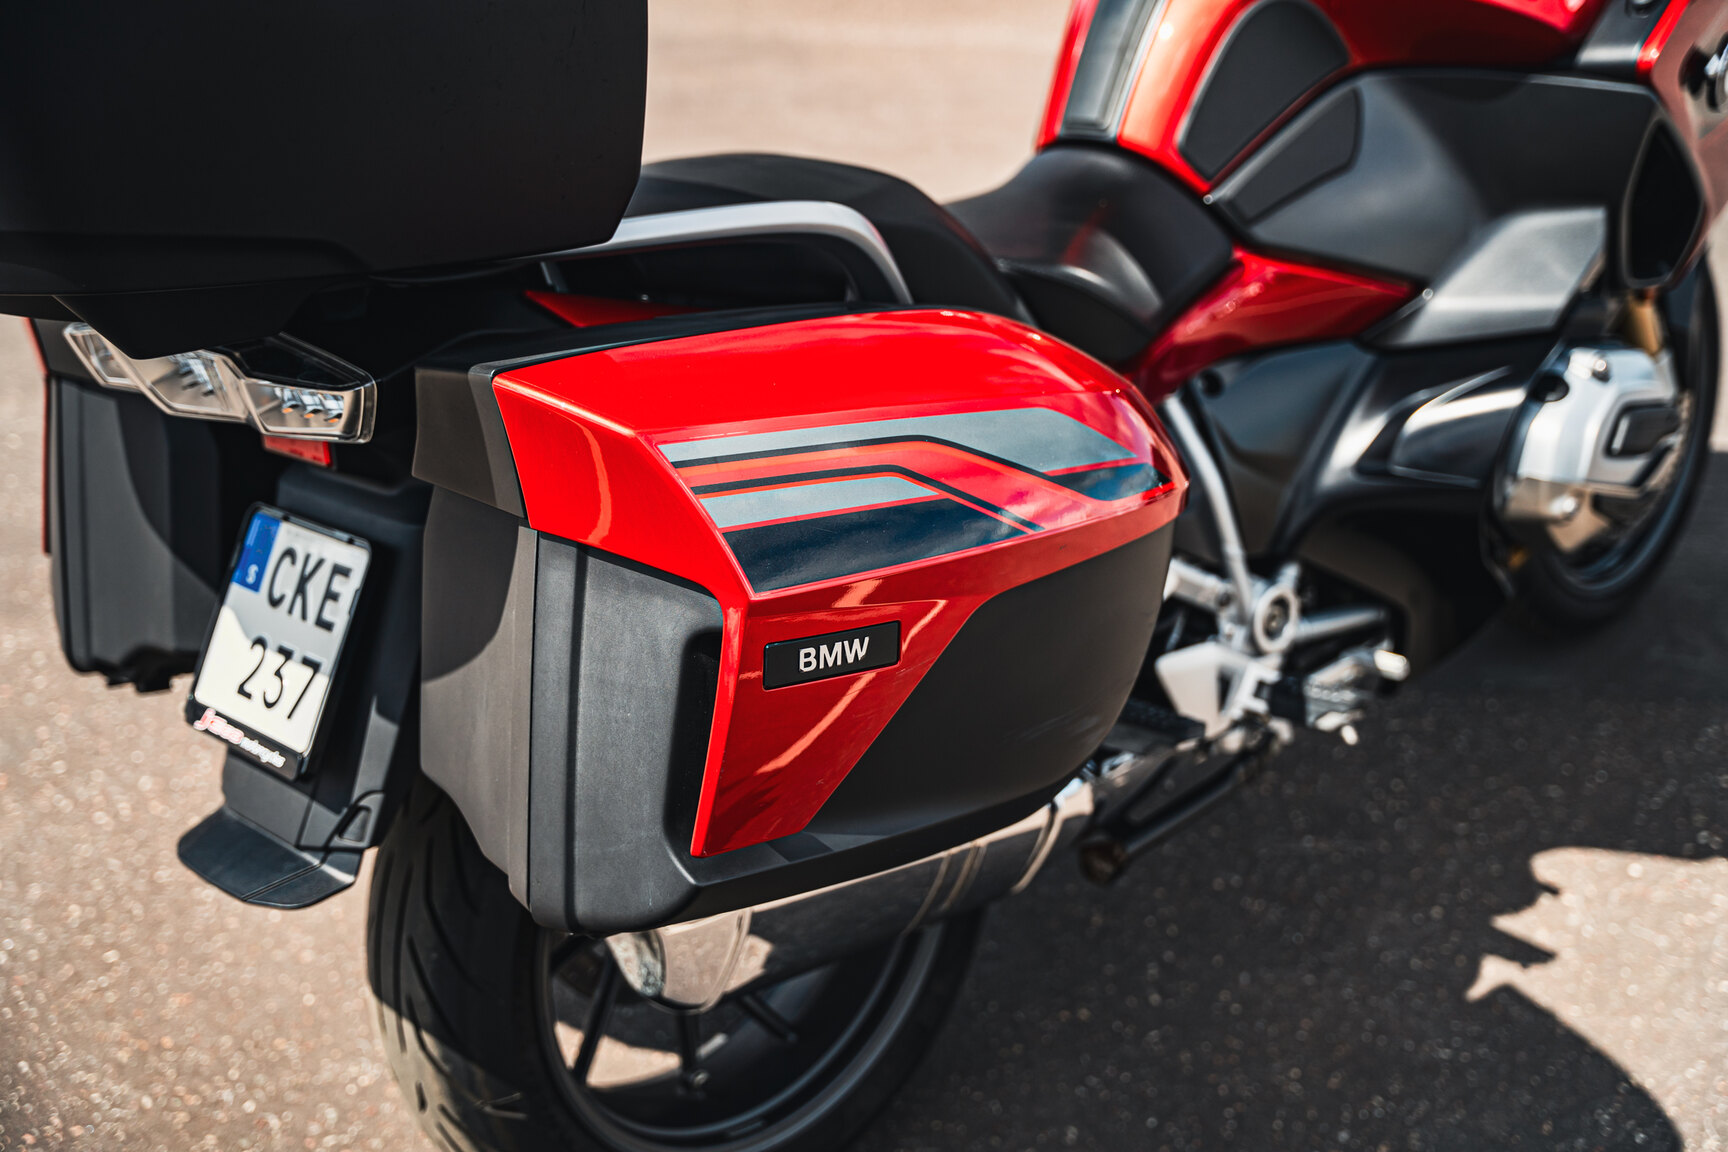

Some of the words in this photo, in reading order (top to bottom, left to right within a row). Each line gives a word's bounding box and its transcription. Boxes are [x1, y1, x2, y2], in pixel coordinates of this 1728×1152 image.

[245, 563, 259, 585] S
[267, 546, 351, 631] CKE
[237, 636, 321, 719] 237
[799, 636, 870, 672] BMW
